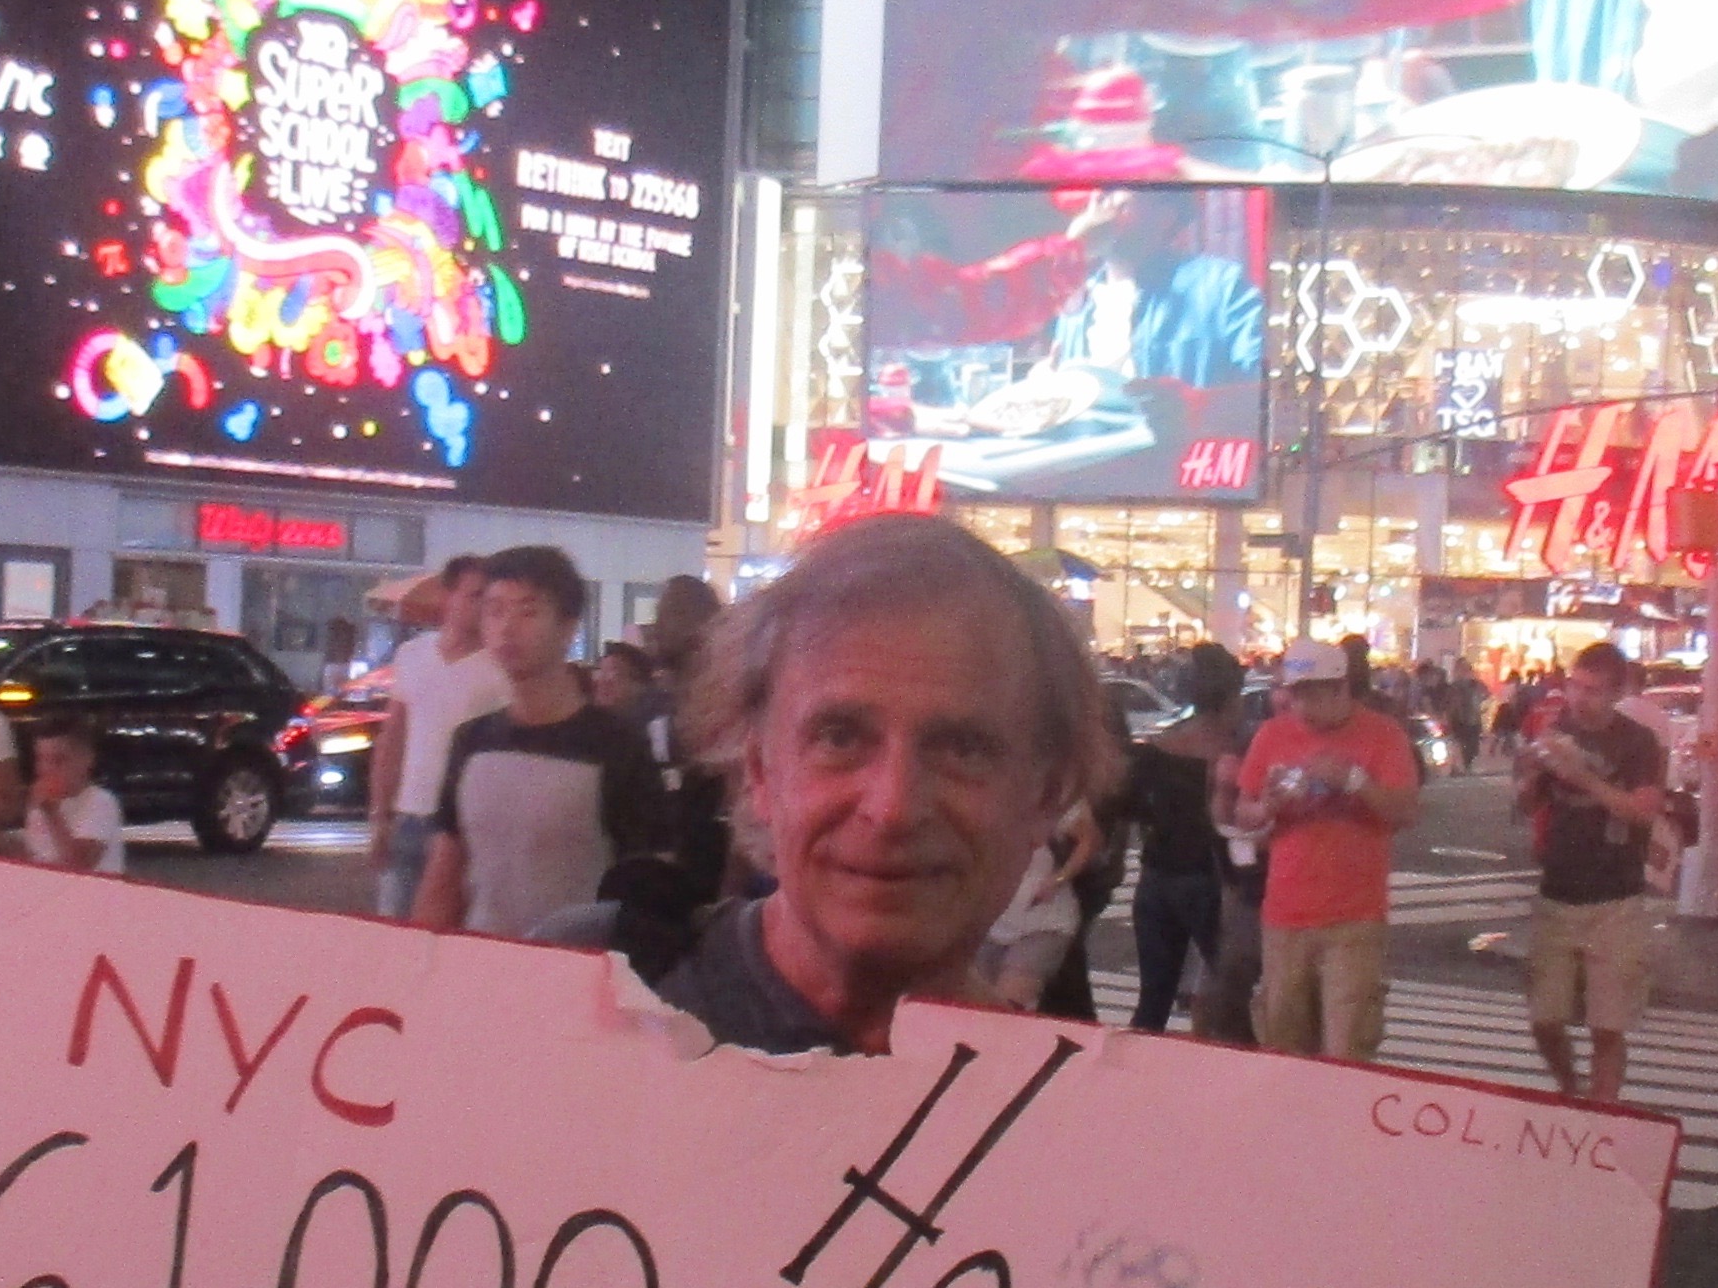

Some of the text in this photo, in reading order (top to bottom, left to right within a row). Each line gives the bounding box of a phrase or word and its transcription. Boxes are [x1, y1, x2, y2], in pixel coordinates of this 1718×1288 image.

[259, 107, 376, 173] SCHOOL
[280, 161, 353, 213] LIVE
[1179, 440, 1251, 489] H&M
[67, 954, 405, 1127] NYC
[1516, 1121, 1620, 1172] NYC
